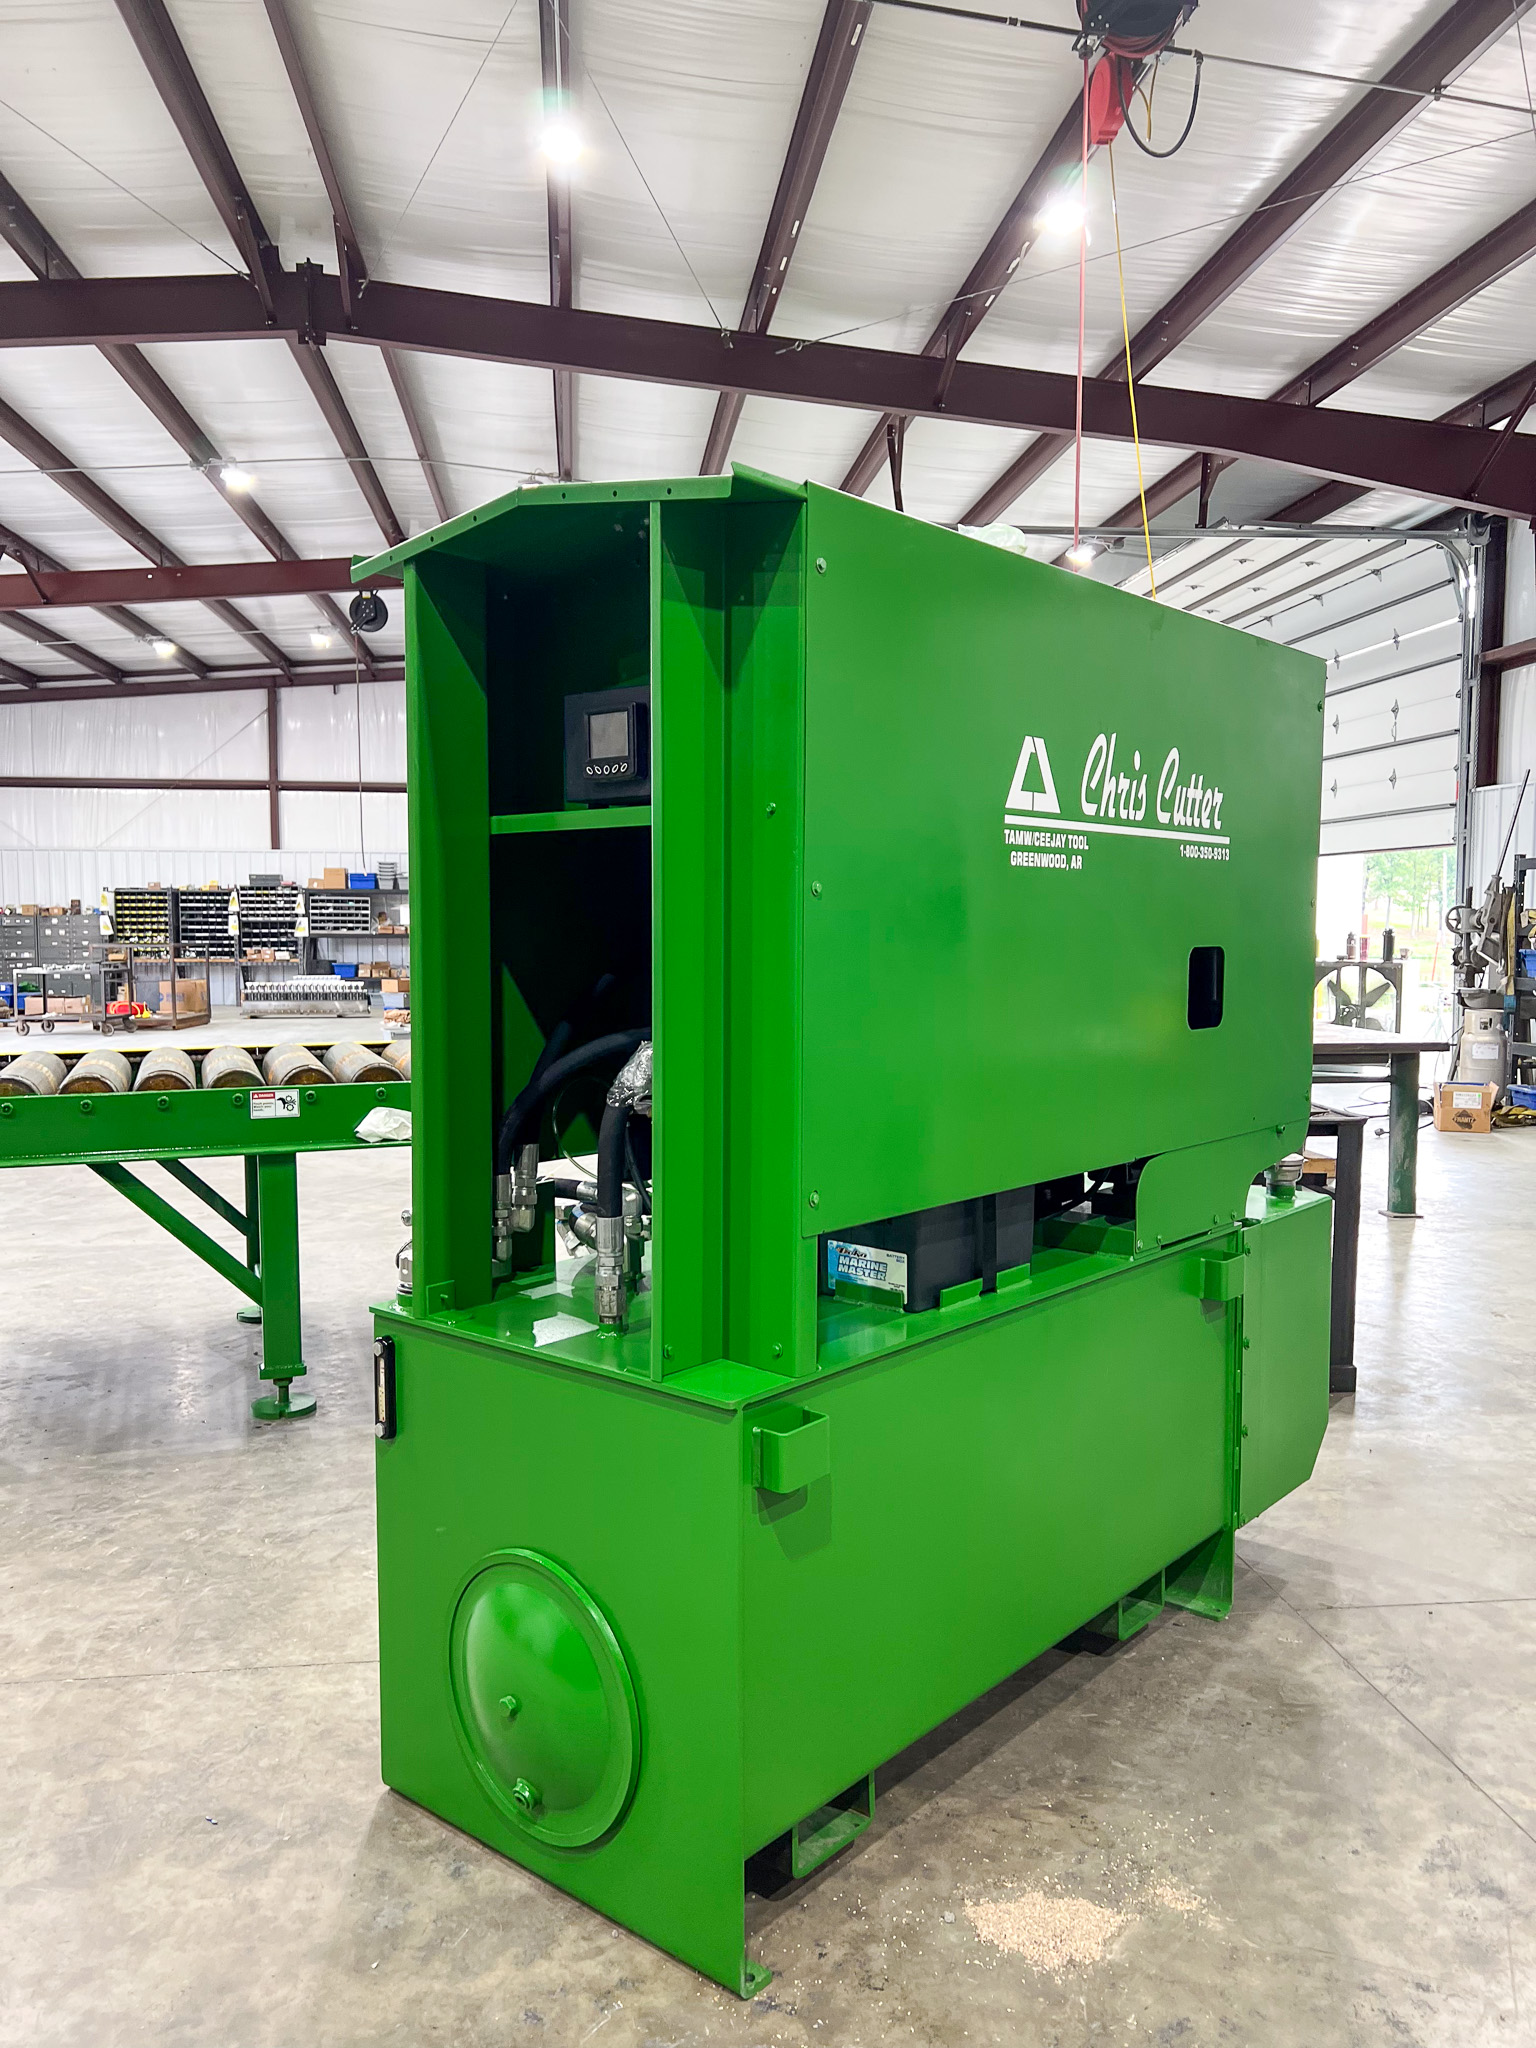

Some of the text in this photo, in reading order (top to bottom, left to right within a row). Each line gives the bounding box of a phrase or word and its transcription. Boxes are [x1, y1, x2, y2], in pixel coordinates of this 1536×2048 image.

[1081, 732, 1224, 830] Chris Cutter
[1004, 829, 1089, 850] TAMW/CEEJAY TOOL
[1010, 851, 1083, 871] GREENWOOD, AR
[1179, 844, 1230, 861] 1-800-350-9313
[837, 1264, 887, 1281] MASTER
[838, 1255, 887, 1272] MARINE
